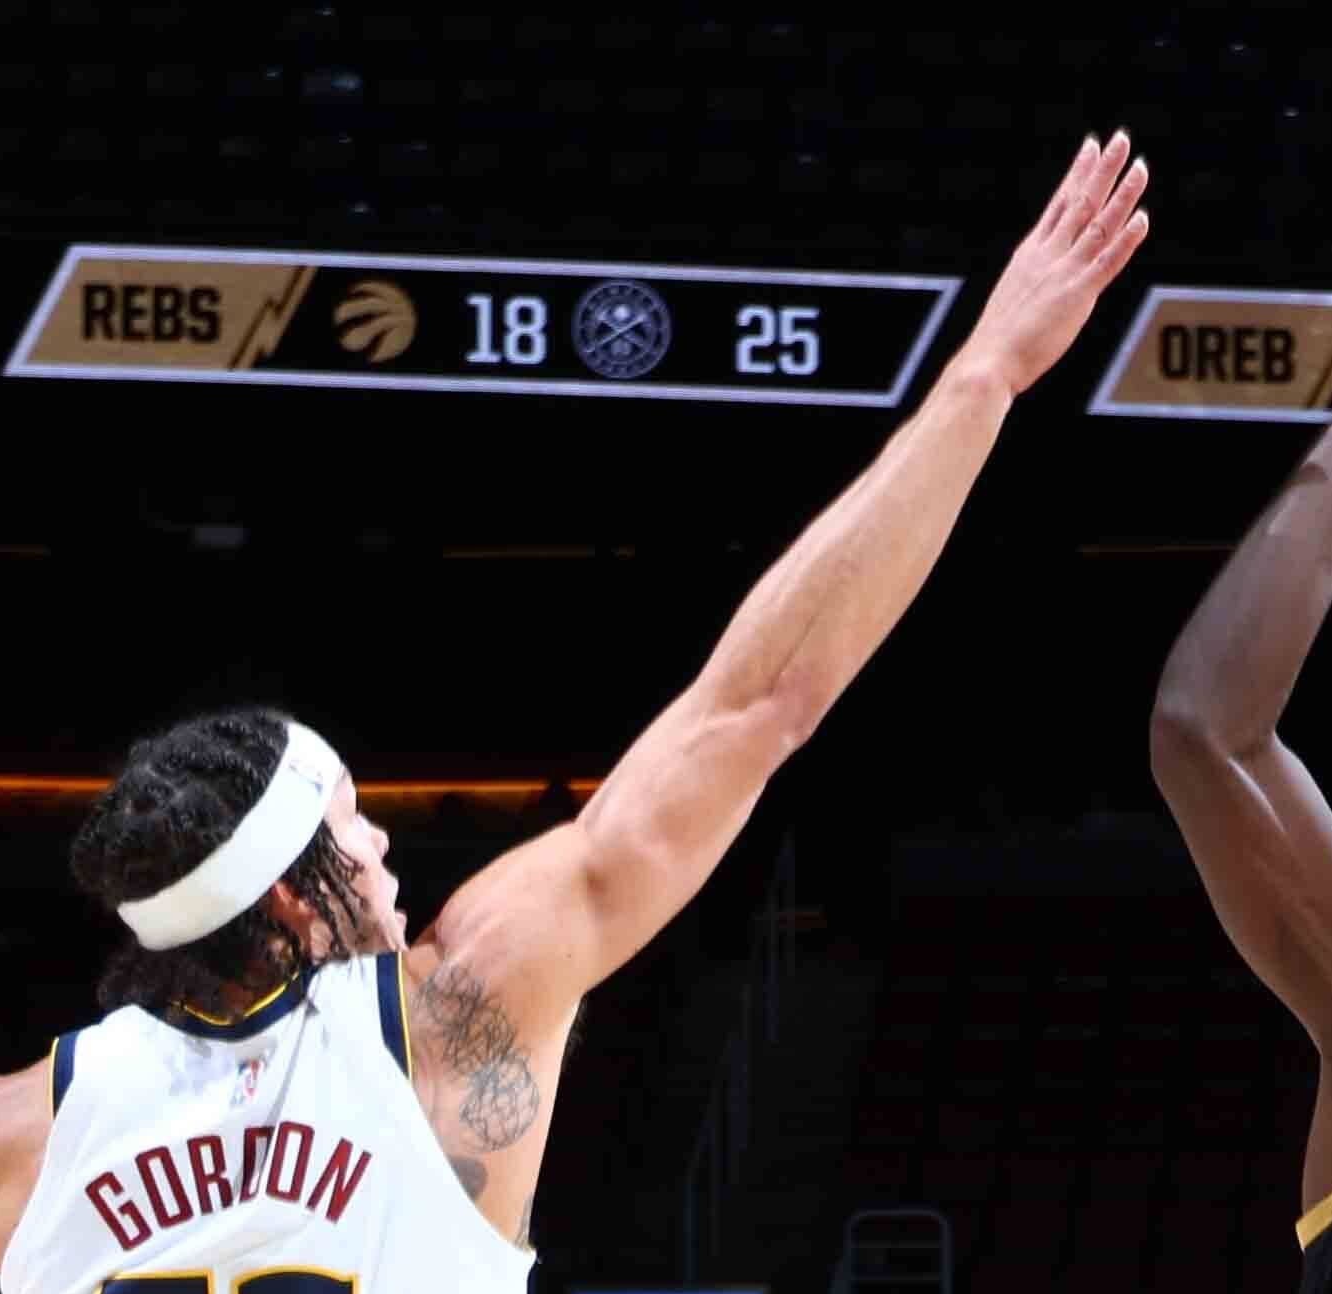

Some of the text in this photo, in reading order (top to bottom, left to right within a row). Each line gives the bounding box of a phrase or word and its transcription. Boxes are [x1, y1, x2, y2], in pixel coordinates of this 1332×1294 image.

[82, 283, 224, 345] REBS
[466, 296, 547, 366] 18
[736, 306, 820, 376] 25
[1159, 323, 1295, 386] OREB
[84, 1120, 373, 1252] GORDON
